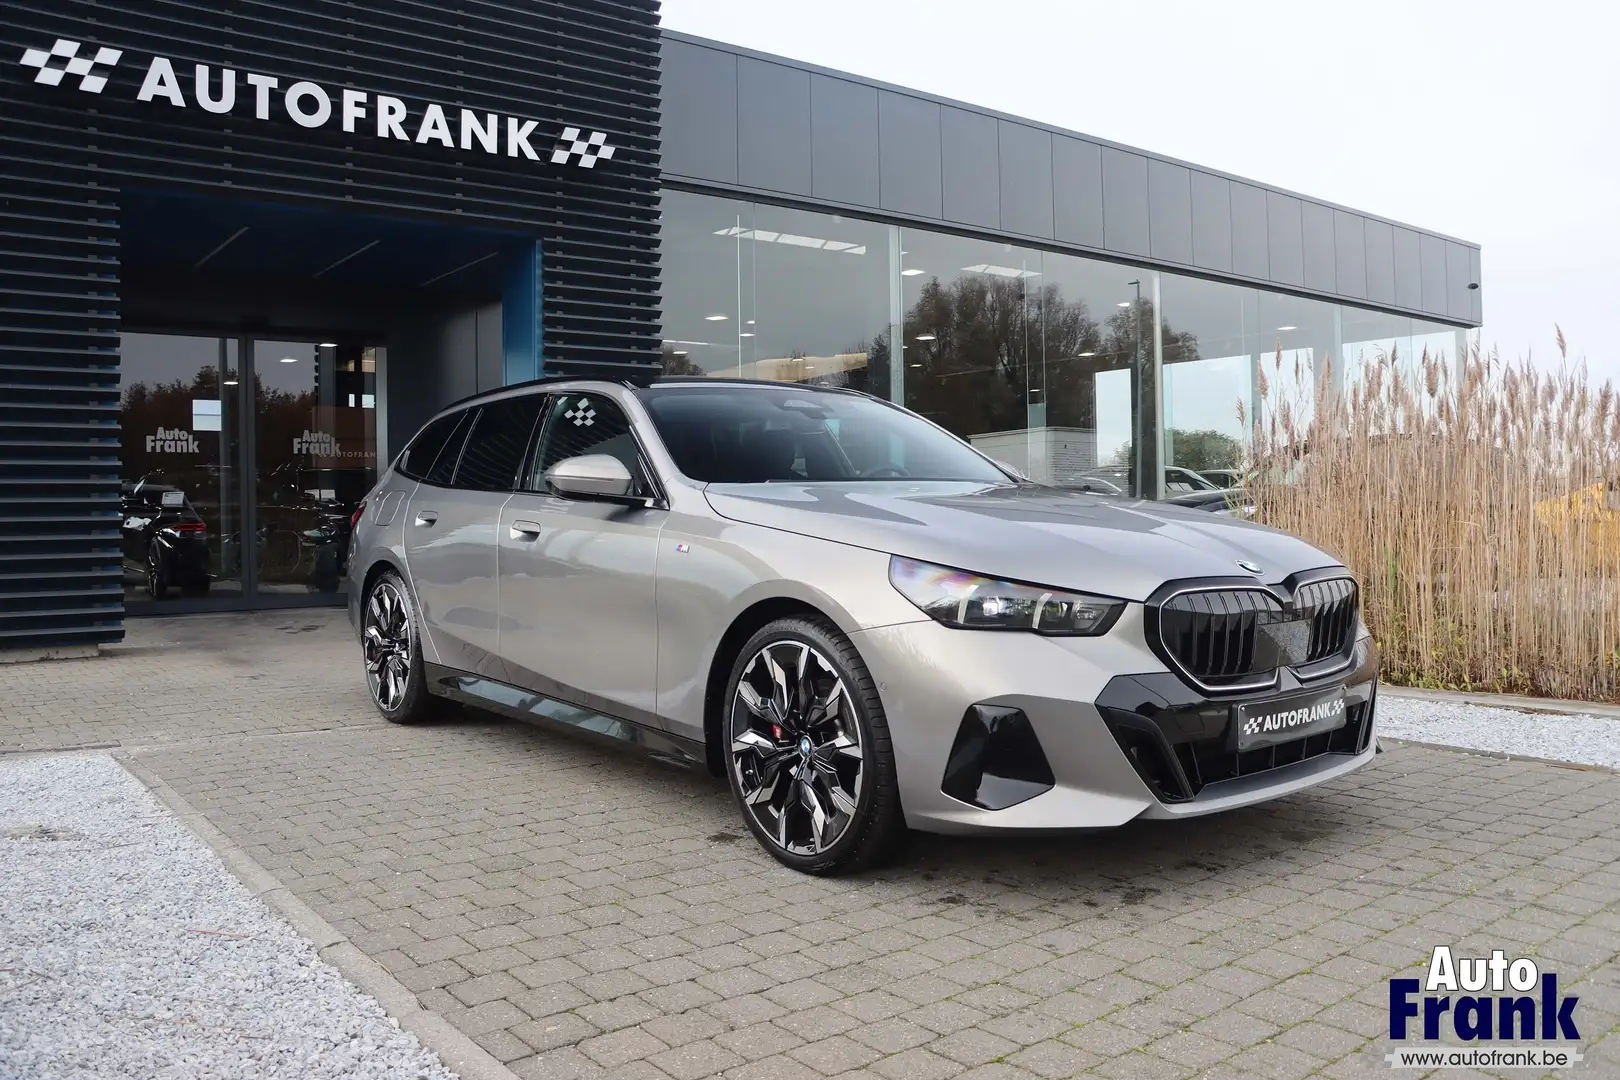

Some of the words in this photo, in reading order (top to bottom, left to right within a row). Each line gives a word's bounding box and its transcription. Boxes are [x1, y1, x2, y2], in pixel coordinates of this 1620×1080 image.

[137, 57, 541, 161] AUTOFRANK
[156, 426, 188, 440] Auto
[302, 429, 331, 443] Auto
[145, 434, 200, 453] Frank
[293, 437, 341, 455] Frank
[1263, 702, 1332, 732] AUTOFRANK
